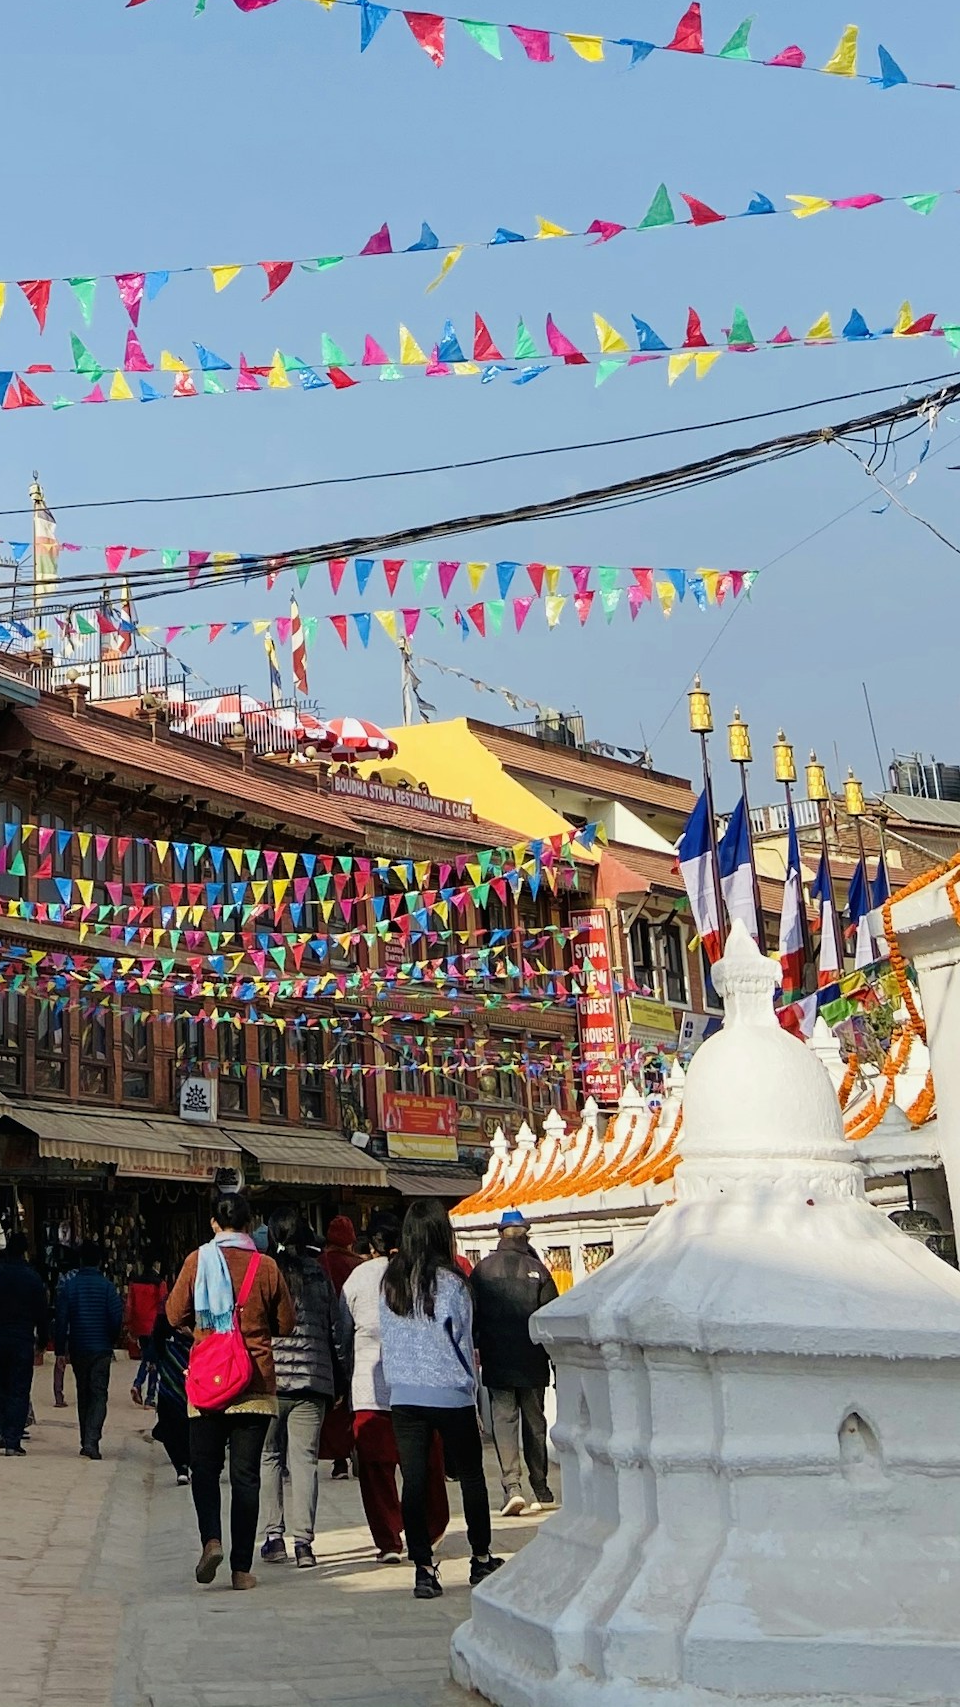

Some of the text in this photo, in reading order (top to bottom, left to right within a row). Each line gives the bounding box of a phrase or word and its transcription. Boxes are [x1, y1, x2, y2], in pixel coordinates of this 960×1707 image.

[334, 776, 472, 819] BOUDHA STUPA RESTAURANT & CAFE
[575, 942, 607, 959] STUPA
[578, 970, 608, 987] VIEW
[580, 998, 611, 1015] GUEST
[582, 1027, 614, 1044] HOUSE
[586, 1074, 618, 1085] CAFE
